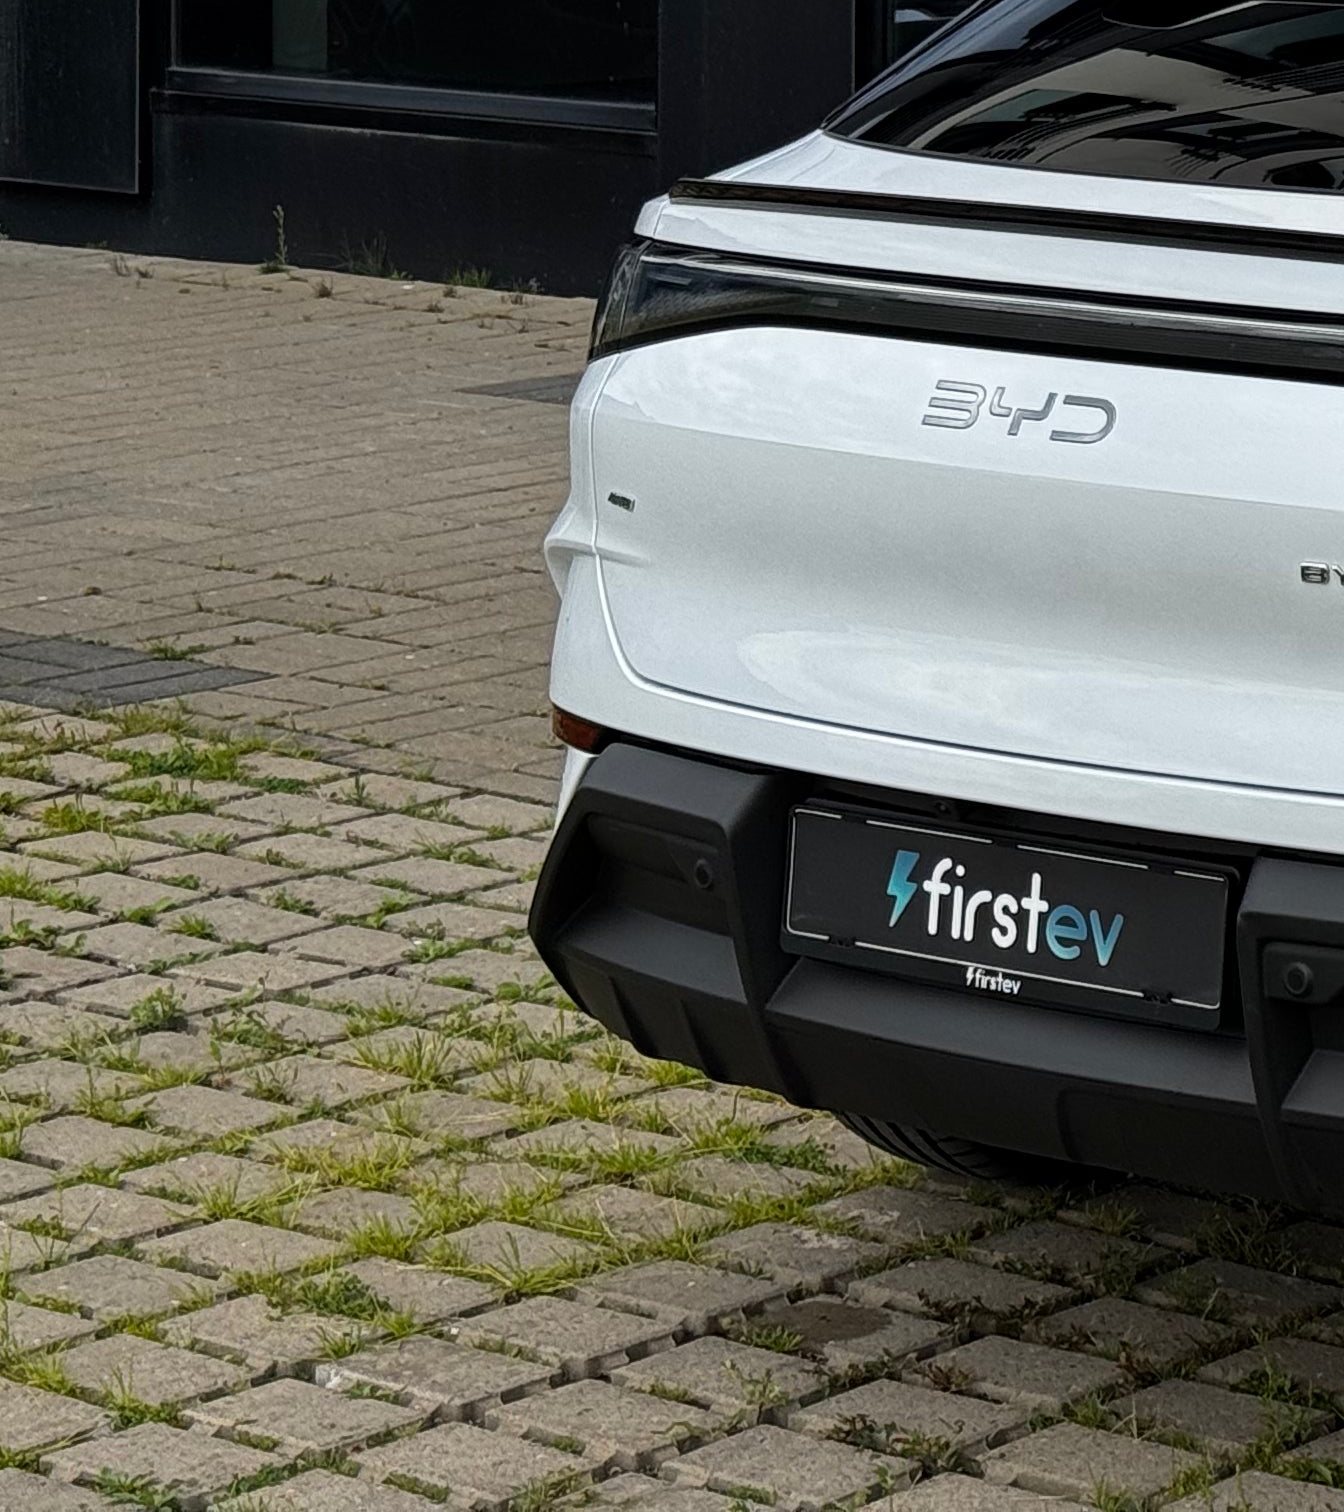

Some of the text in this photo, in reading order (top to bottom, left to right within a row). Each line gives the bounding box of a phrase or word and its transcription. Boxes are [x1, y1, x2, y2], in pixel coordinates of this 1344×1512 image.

[921, 379, 1118, 445] BYD
[922, 856, 1125, 967] firstev
[974, 968, 1022, 995] firstev
